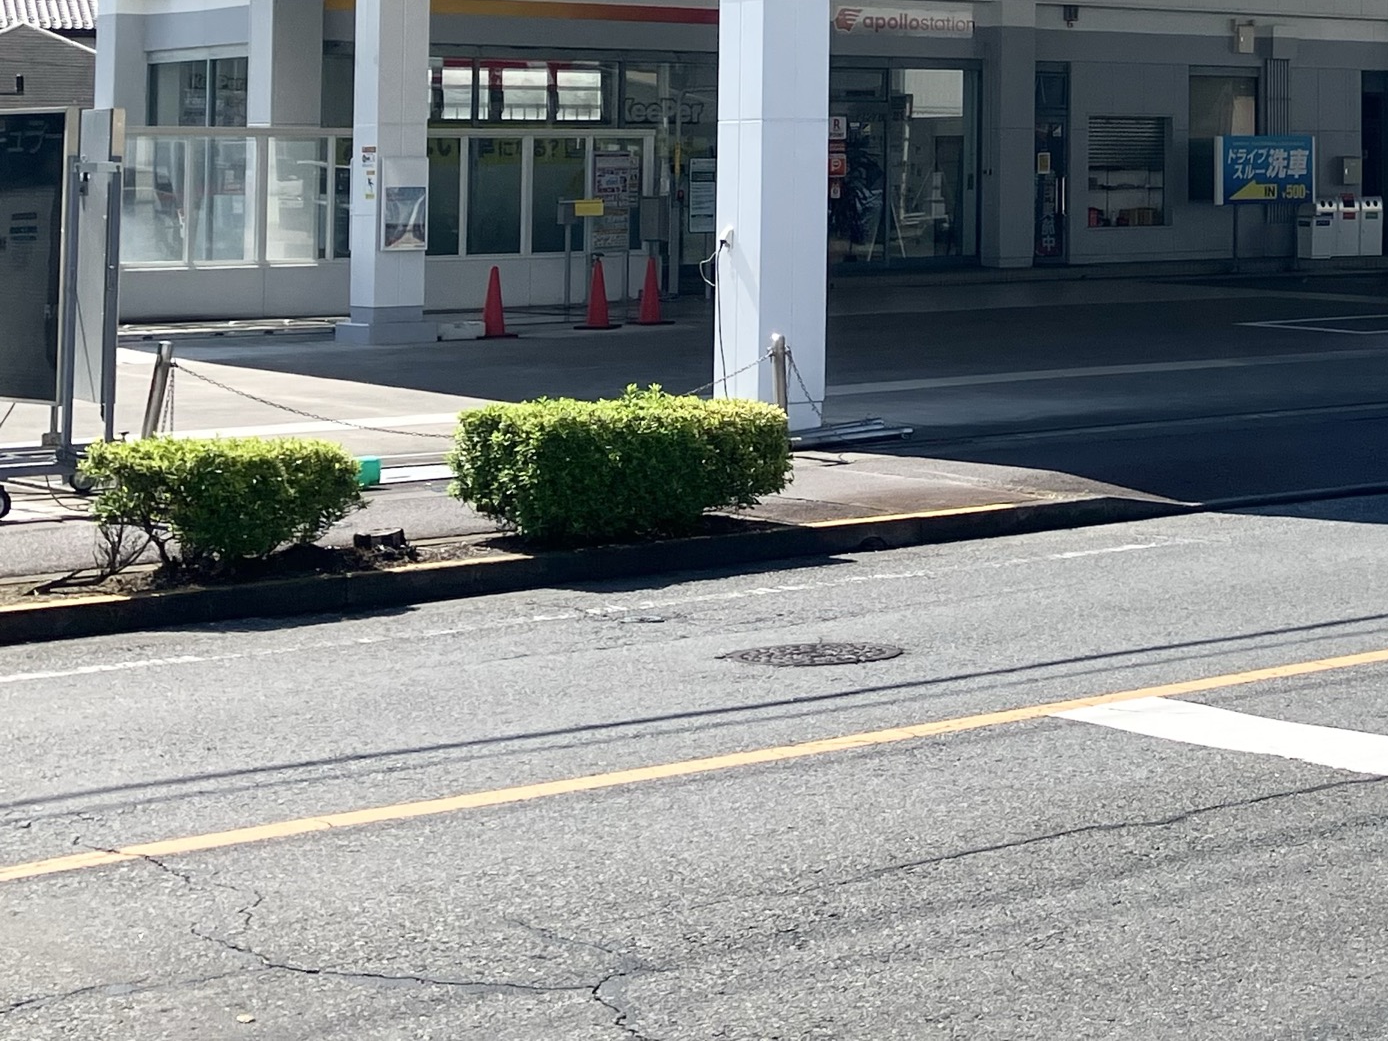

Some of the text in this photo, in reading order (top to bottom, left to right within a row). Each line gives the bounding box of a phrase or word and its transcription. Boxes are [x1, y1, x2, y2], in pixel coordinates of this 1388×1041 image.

[861, 11, 974, 35] apollostation
[1227, 148, 1268, 165] ドライブ
[1266, 148, 1310, 179] 洗車
[1232, 164, 1266, 180] スルー
[1264, 185, 1276, 198] IN
